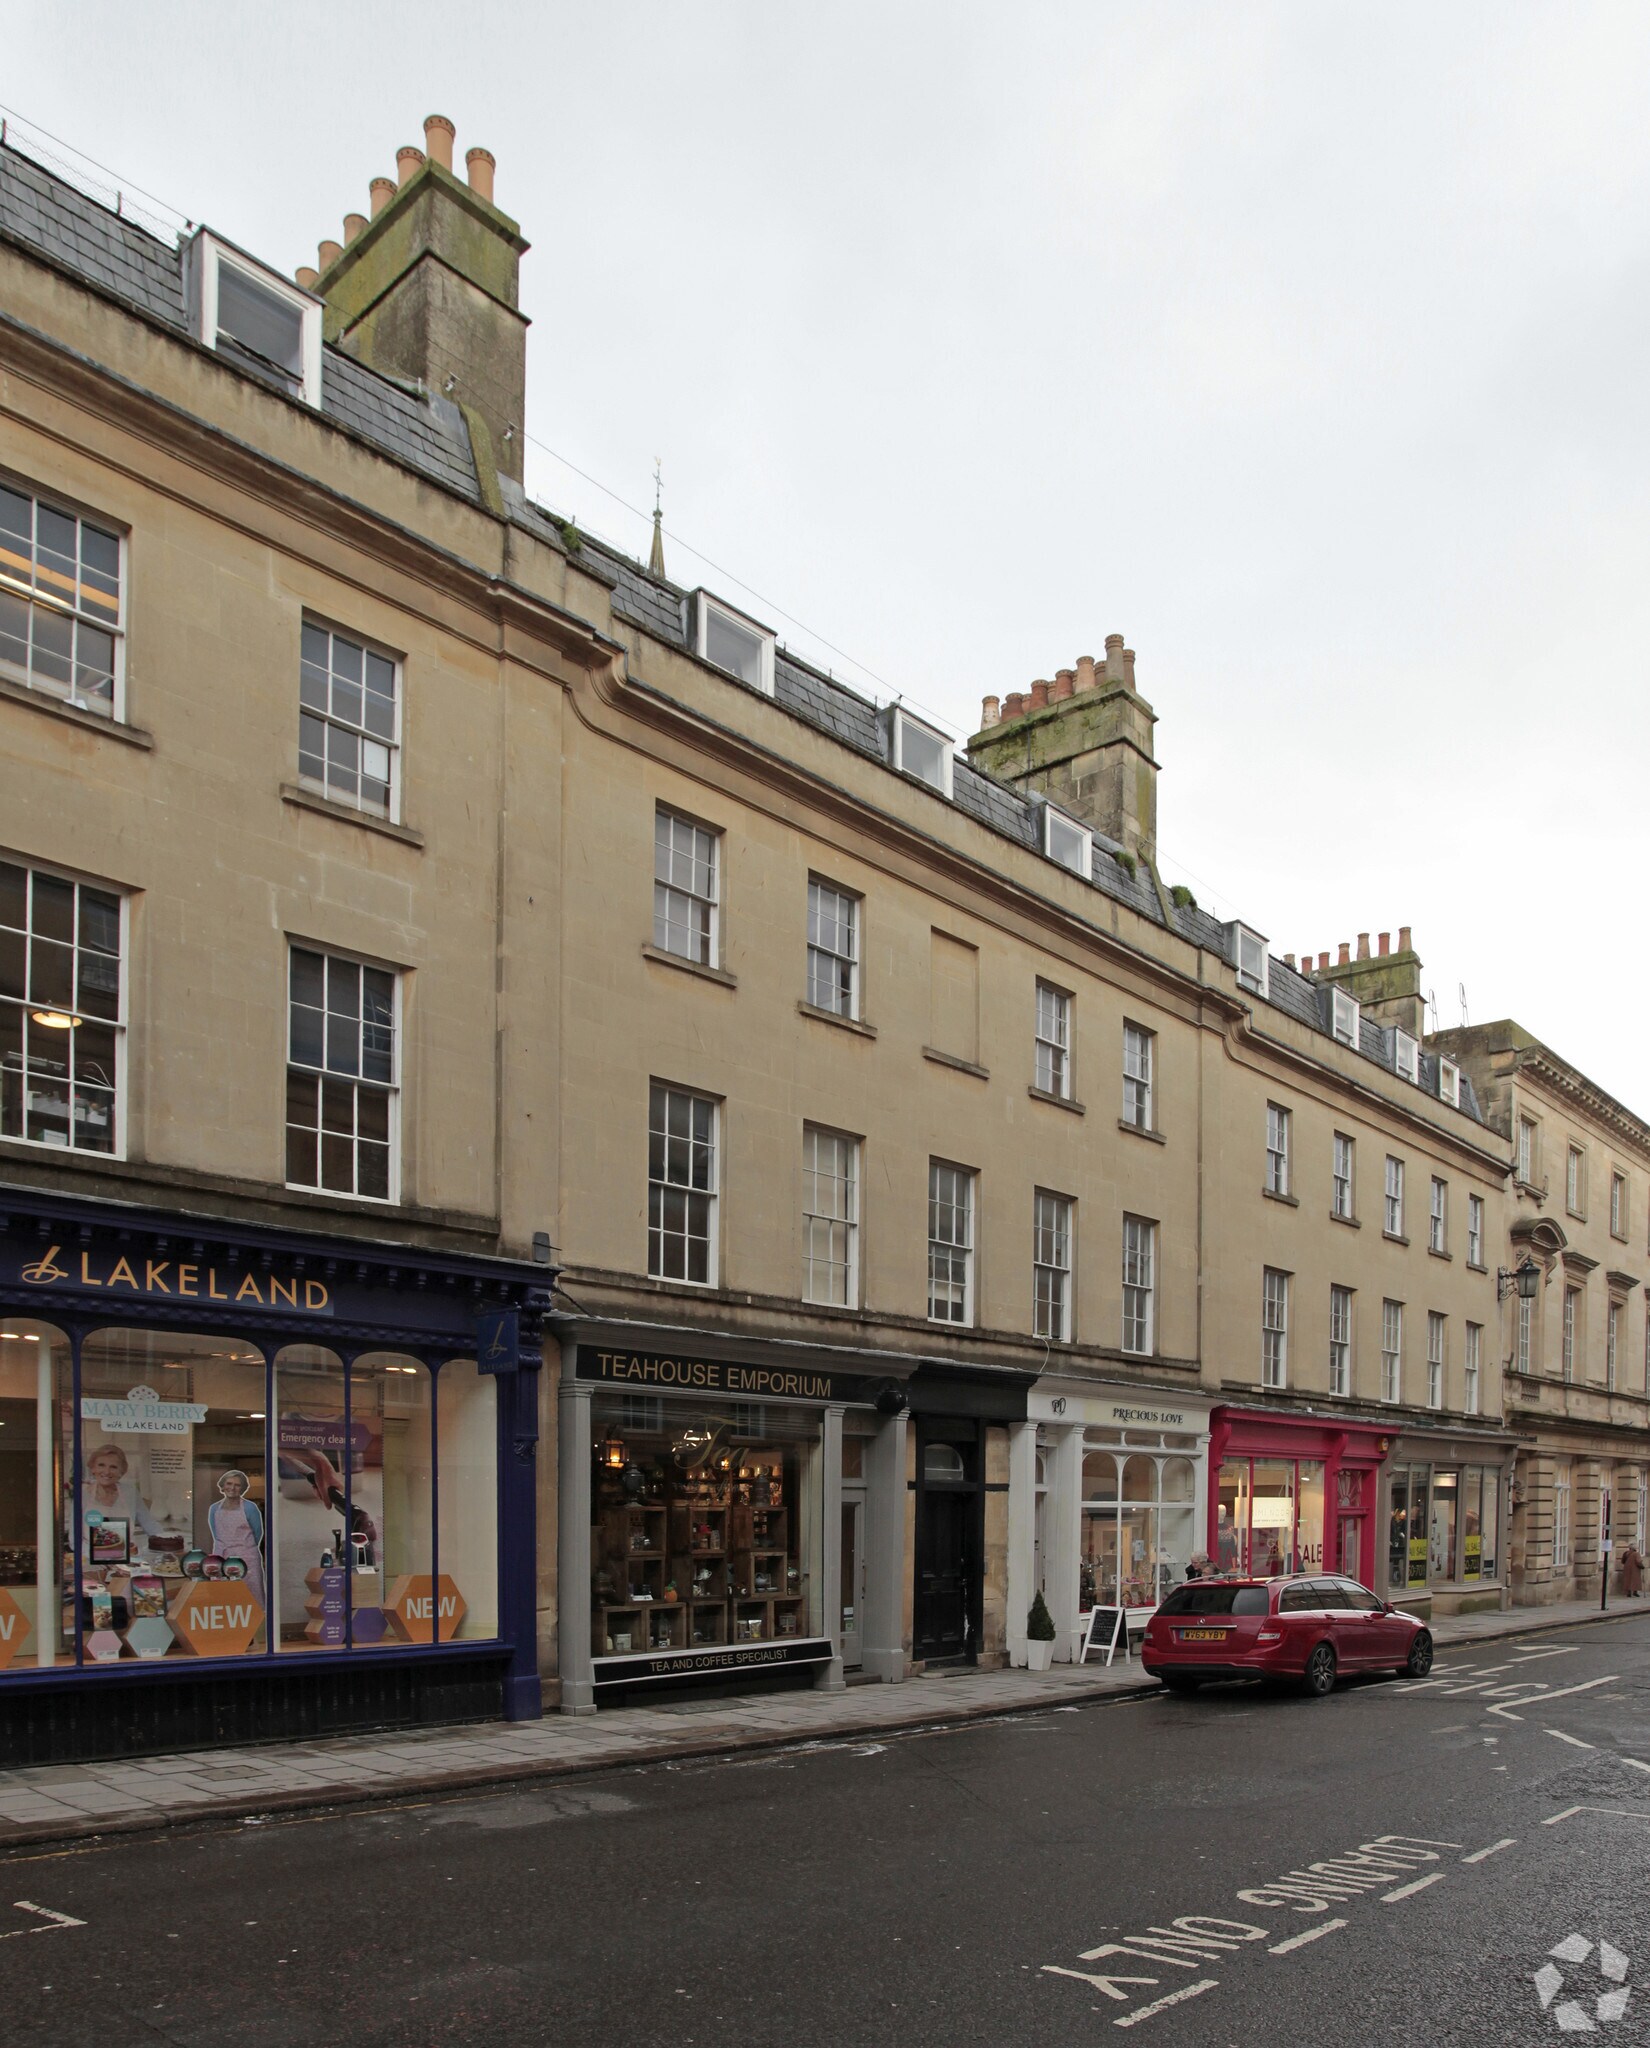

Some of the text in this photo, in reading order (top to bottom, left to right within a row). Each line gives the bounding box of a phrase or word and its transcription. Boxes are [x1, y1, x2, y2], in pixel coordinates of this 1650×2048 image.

[81, 1251, 329, 1309] LAKELAND
[597, 1353, 832, 1398] TEAHOUSE EMPORIUM
[83, 1401, 205, 1420] MARY BERRY
[1112, 1407, 1184, 1424] PRECIOUS LOVE
[107, 1419, 185, 1431] with LAKELAND
[281, 1432, 357, 1446] Emergency cleaer
[190, 1604, 252, 1630] NEW
[406, 1597, 456, 1619] NEW
[1185, 1630, 1225, 1640] WV63 YBY
[650, 1649, 788, 1672] TEA AND COFFEE SPECIALIST
[1041, 1834, 1463, 2001] LOADING ONLY
